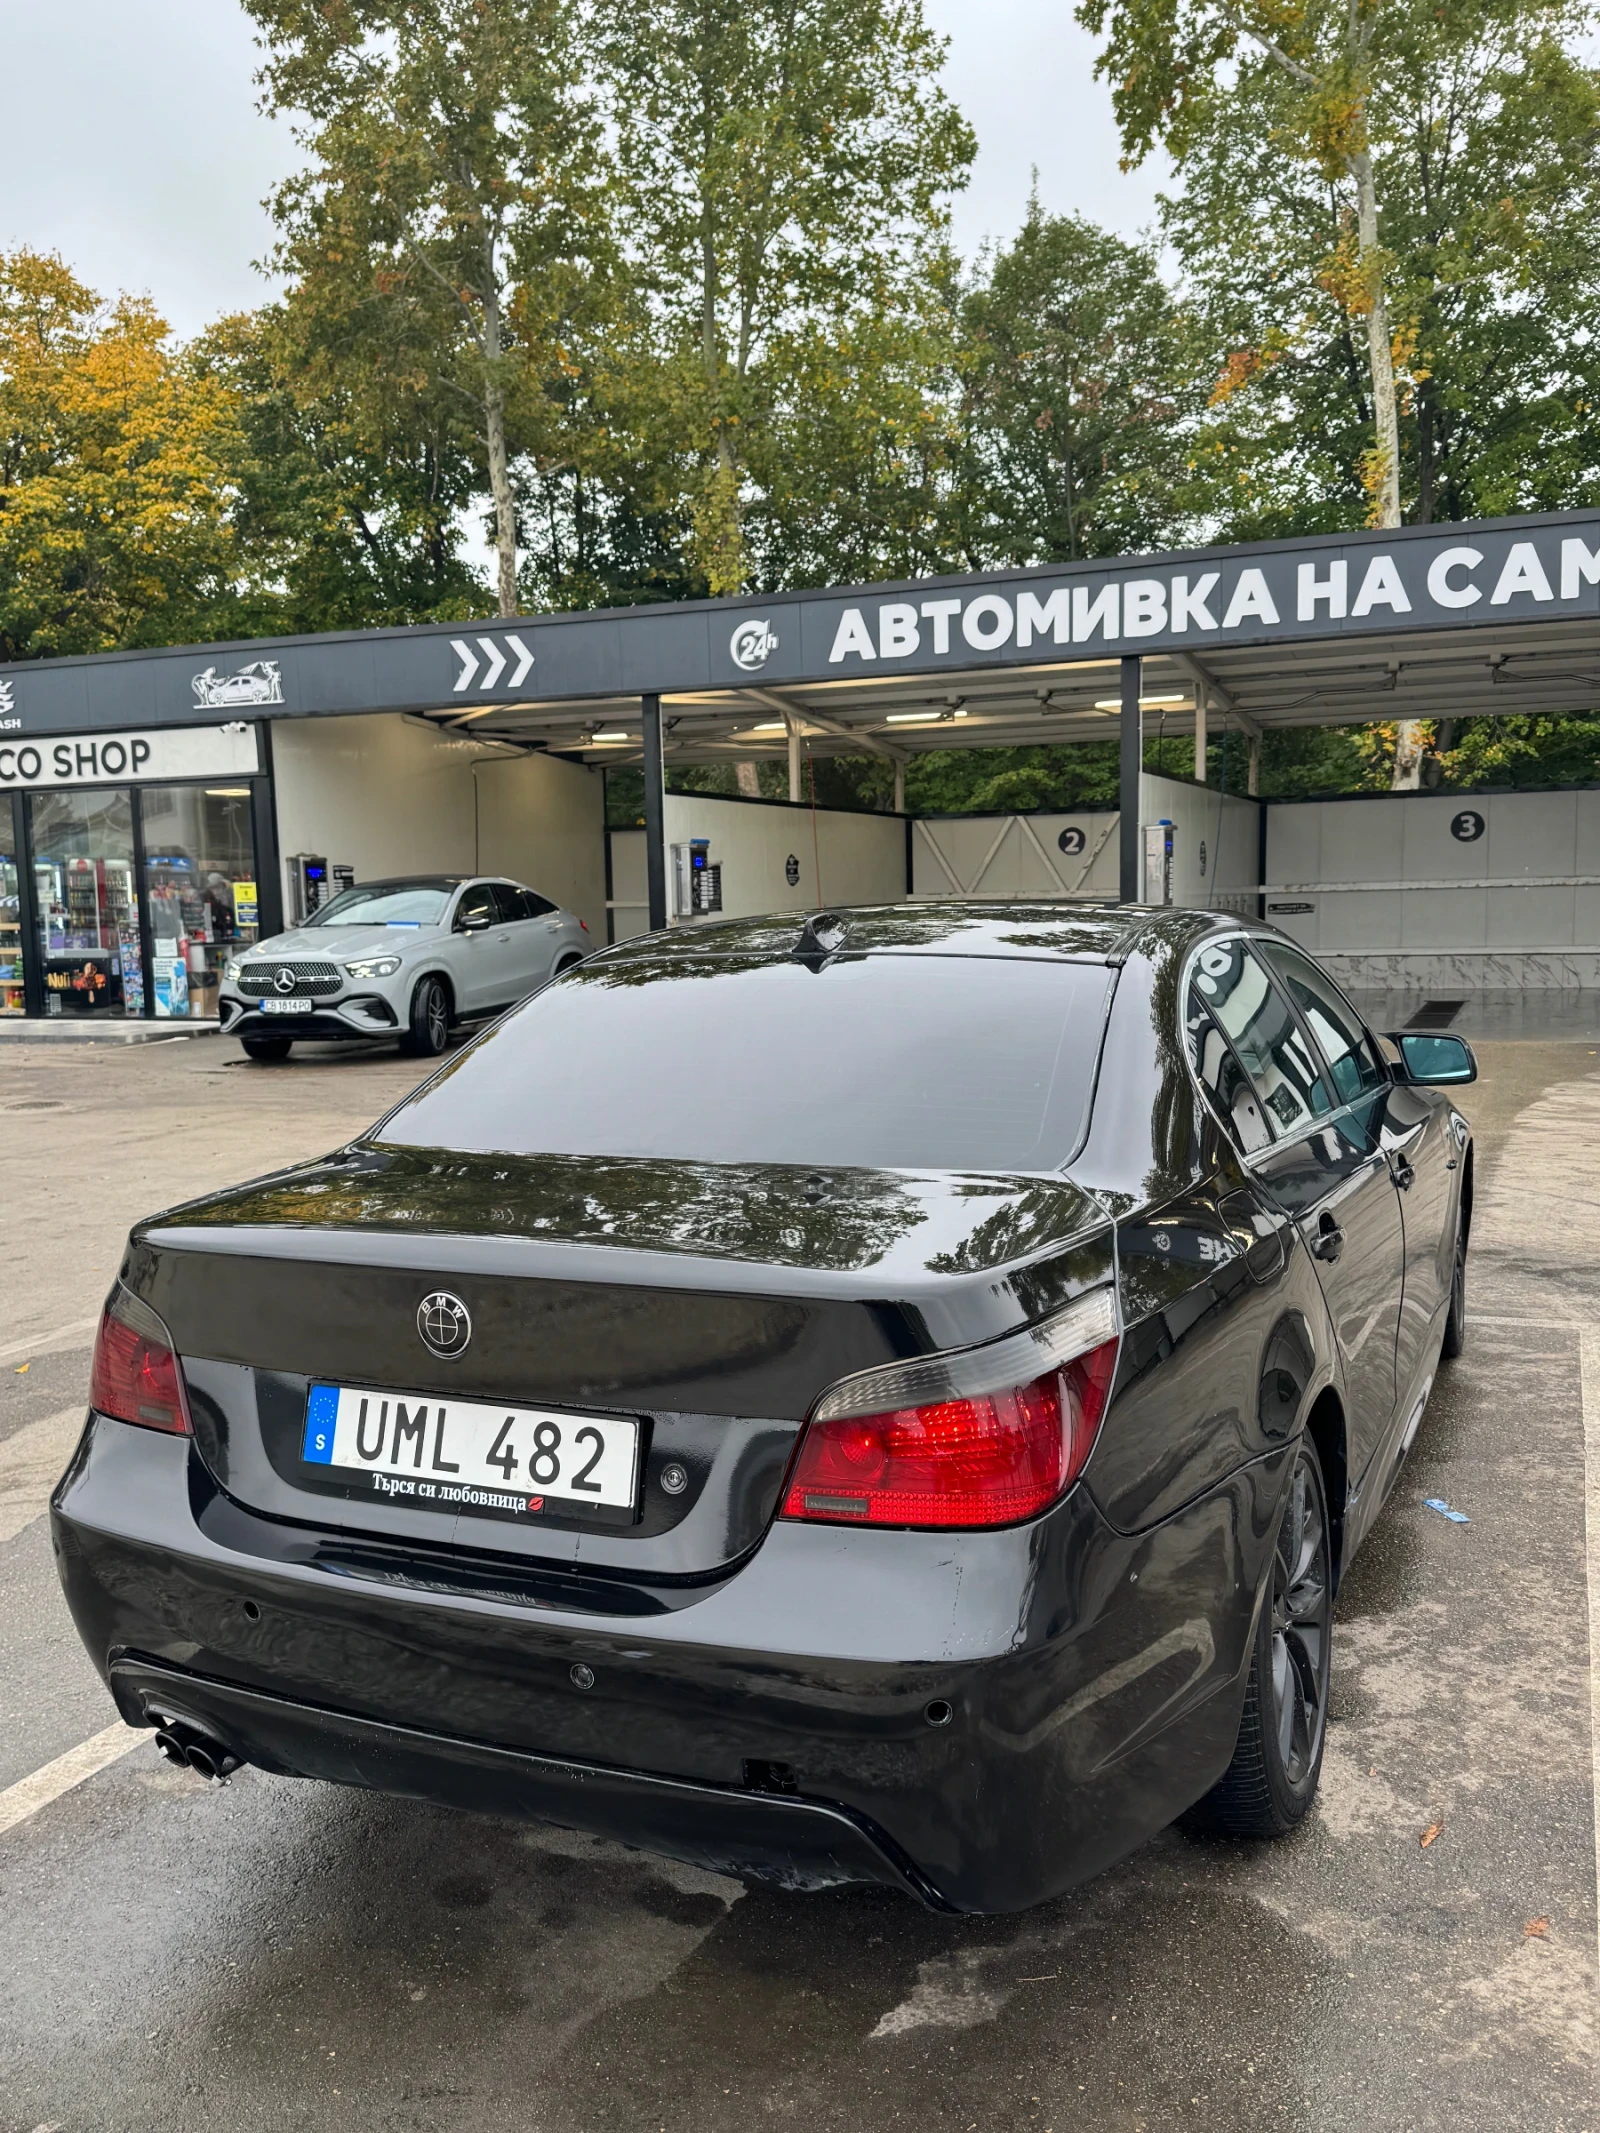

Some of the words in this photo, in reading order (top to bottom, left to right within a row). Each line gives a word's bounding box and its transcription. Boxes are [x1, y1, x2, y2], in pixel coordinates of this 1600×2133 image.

[828, 568, 1281, 663] АВТОМИВКА
[1297, 555, 1412, 622] НА
[740, 633, 779, 662] 24h
[0, 747, 42, 781] CO
[53, 739, 150, 778] SHOP
[1458, 814, 1476, 837] 3
[1065, 831, 1080, 852] 2
[421, 1295, 465, 1319] BMW
[315, 1433, 327, 1451] S
[356, 1398, 460, 1473] UML
[485, 1416, 605, 1493] 482
[372, 1473, 416, 1497] Търся
[418, 1484, 436, 1499] си
[438, 1485, 527, 1514] любовница
